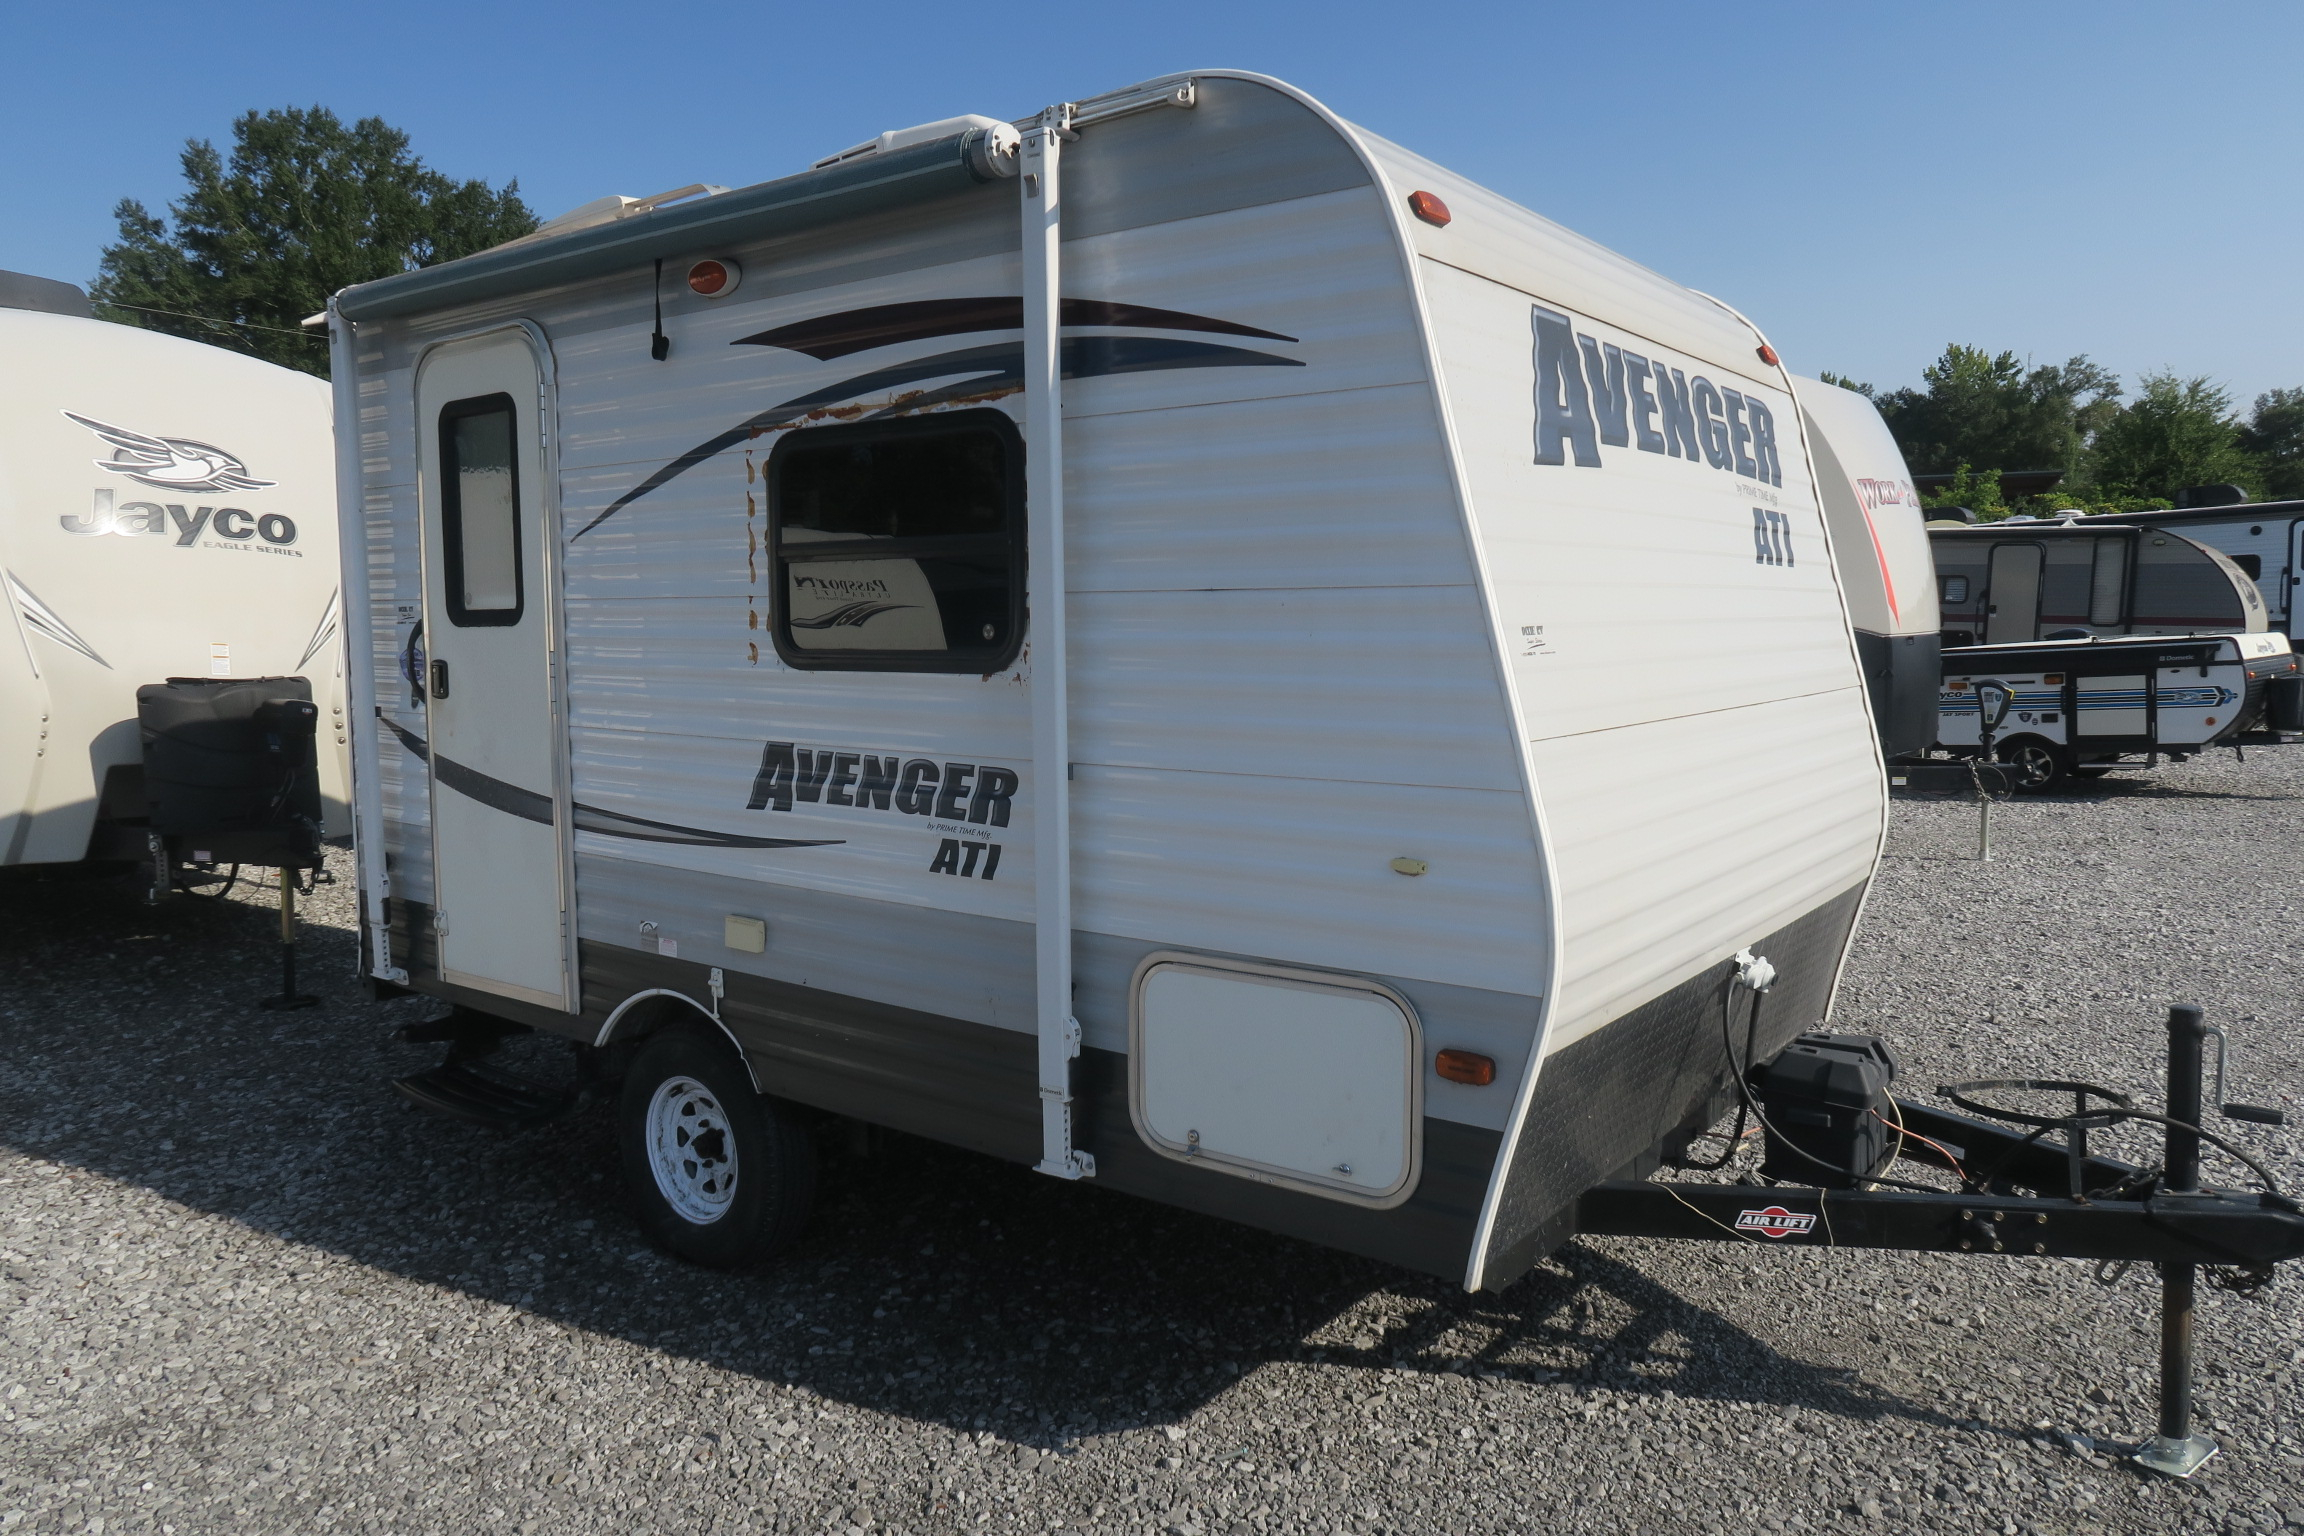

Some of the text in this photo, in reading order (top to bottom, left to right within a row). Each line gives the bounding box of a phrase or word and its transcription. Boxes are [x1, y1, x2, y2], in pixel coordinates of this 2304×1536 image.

[1531, 303, 1783, 489] AVENGER
[1857, 478, 1900, 510] WORK
[59, 488, 299, 547] Jayco
[203, 541, 303, 558] EAGLE SERIES
[1752, 507, 1794, 568] ATI
[1939, 691, 1963, 700] yco
[745, 740, 1020, 829] AVENGER
[926, 821, 936, 831] by
[935, 823, 958, 833] PRIME
[958, 826, 976, 836] TIME
[929, 838, 1001, 880] ATI
[1740, 1215, 1811, 1228] AIR LIFT
